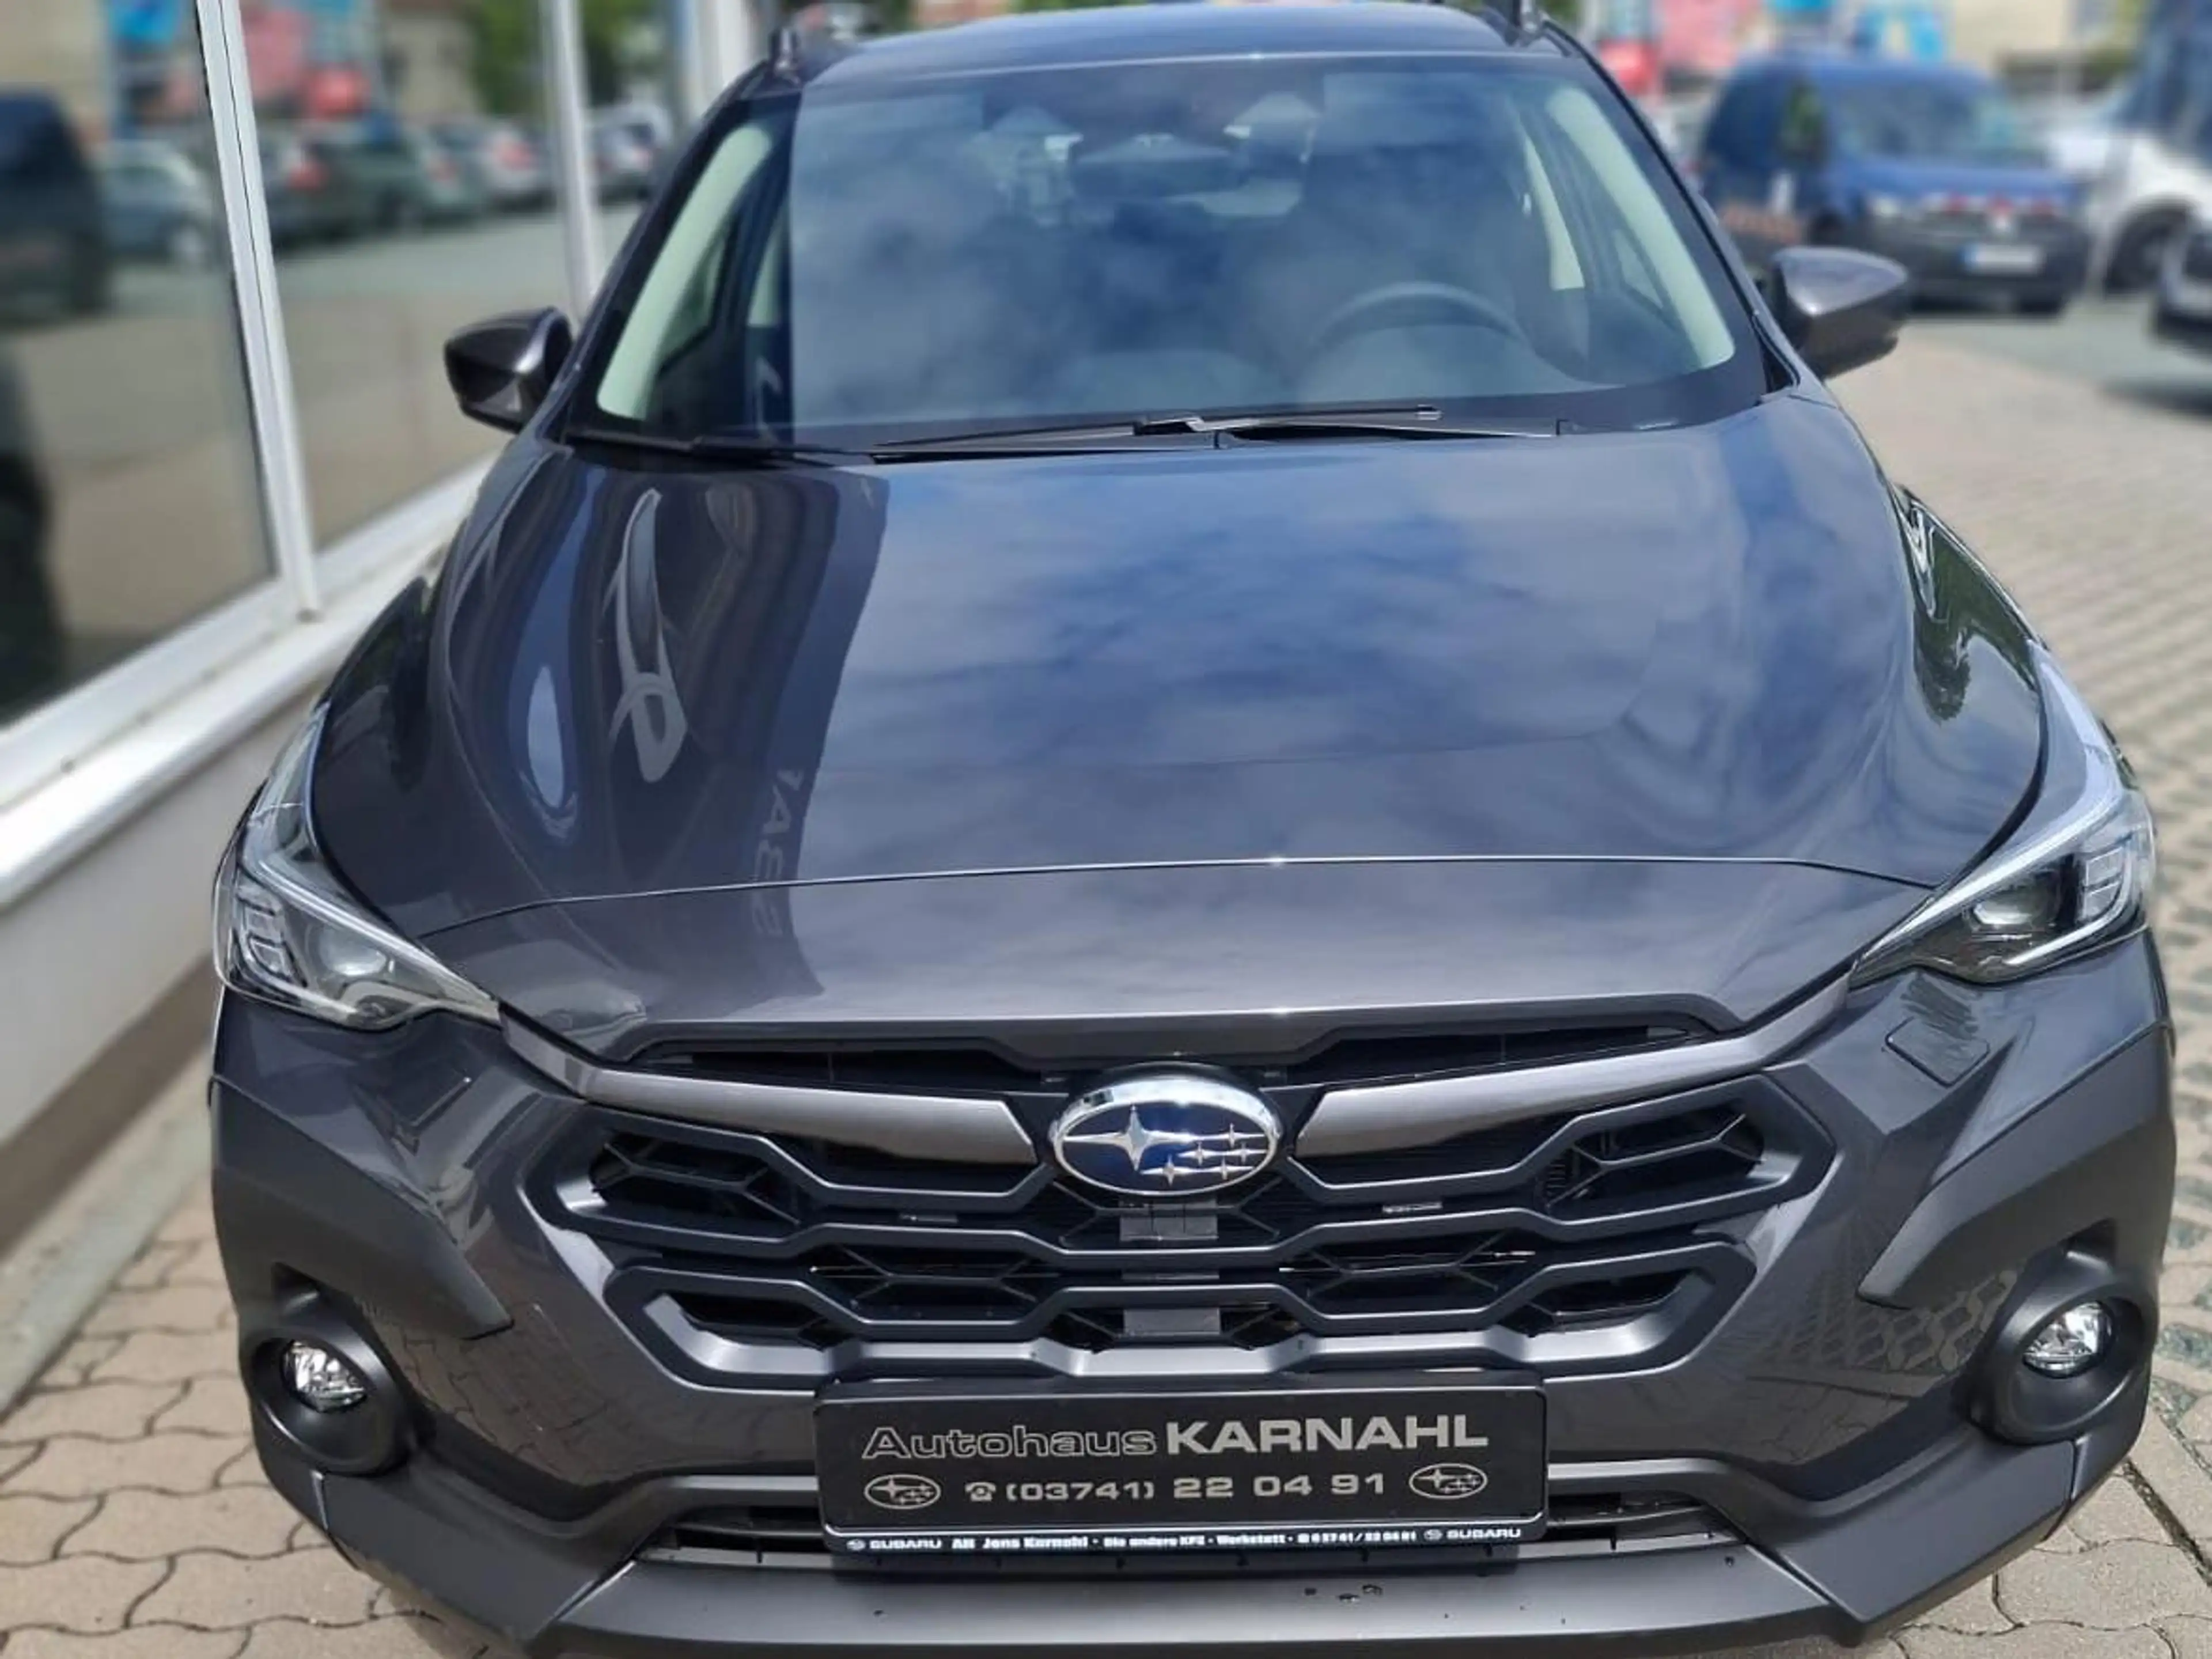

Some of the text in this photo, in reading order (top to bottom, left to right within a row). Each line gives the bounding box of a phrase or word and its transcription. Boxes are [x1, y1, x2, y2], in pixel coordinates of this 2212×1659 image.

[862, 1415, 1488, 1458] Autohaus KARNAHL
[1006, 1472, 1384, 1501] (03741) 22 04 91
[1446, 1528, 1522, 1540] SUBARU
[869, 1539, 942, 1550] SUBARU
